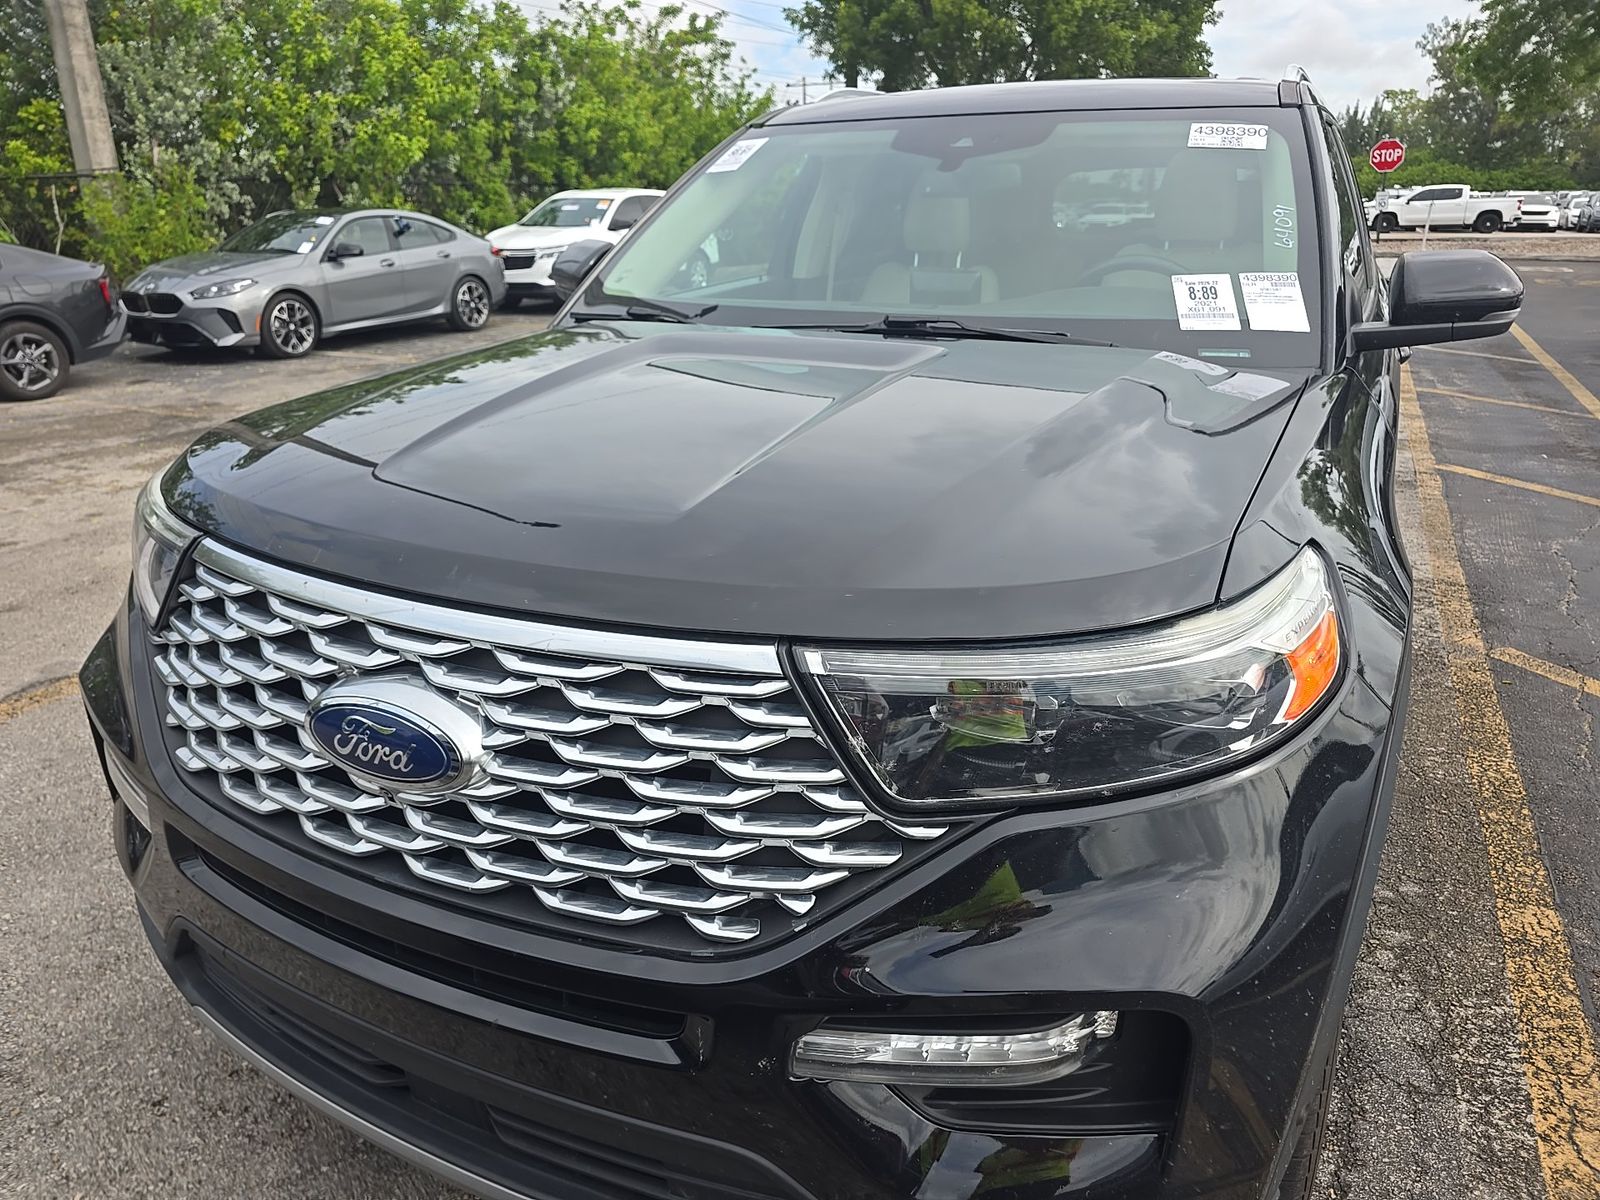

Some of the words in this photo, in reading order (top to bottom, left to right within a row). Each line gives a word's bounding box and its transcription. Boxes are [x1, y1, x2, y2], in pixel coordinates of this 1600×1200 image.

[1194, 126, 1268, 137] 4398390
[1372, 148, 1402, 163] STOP
[1242, 273, 1298, 282] 4398390
[1188, 286, 1218, 300] 8:89
[333, 715, 418, 772] Ford
